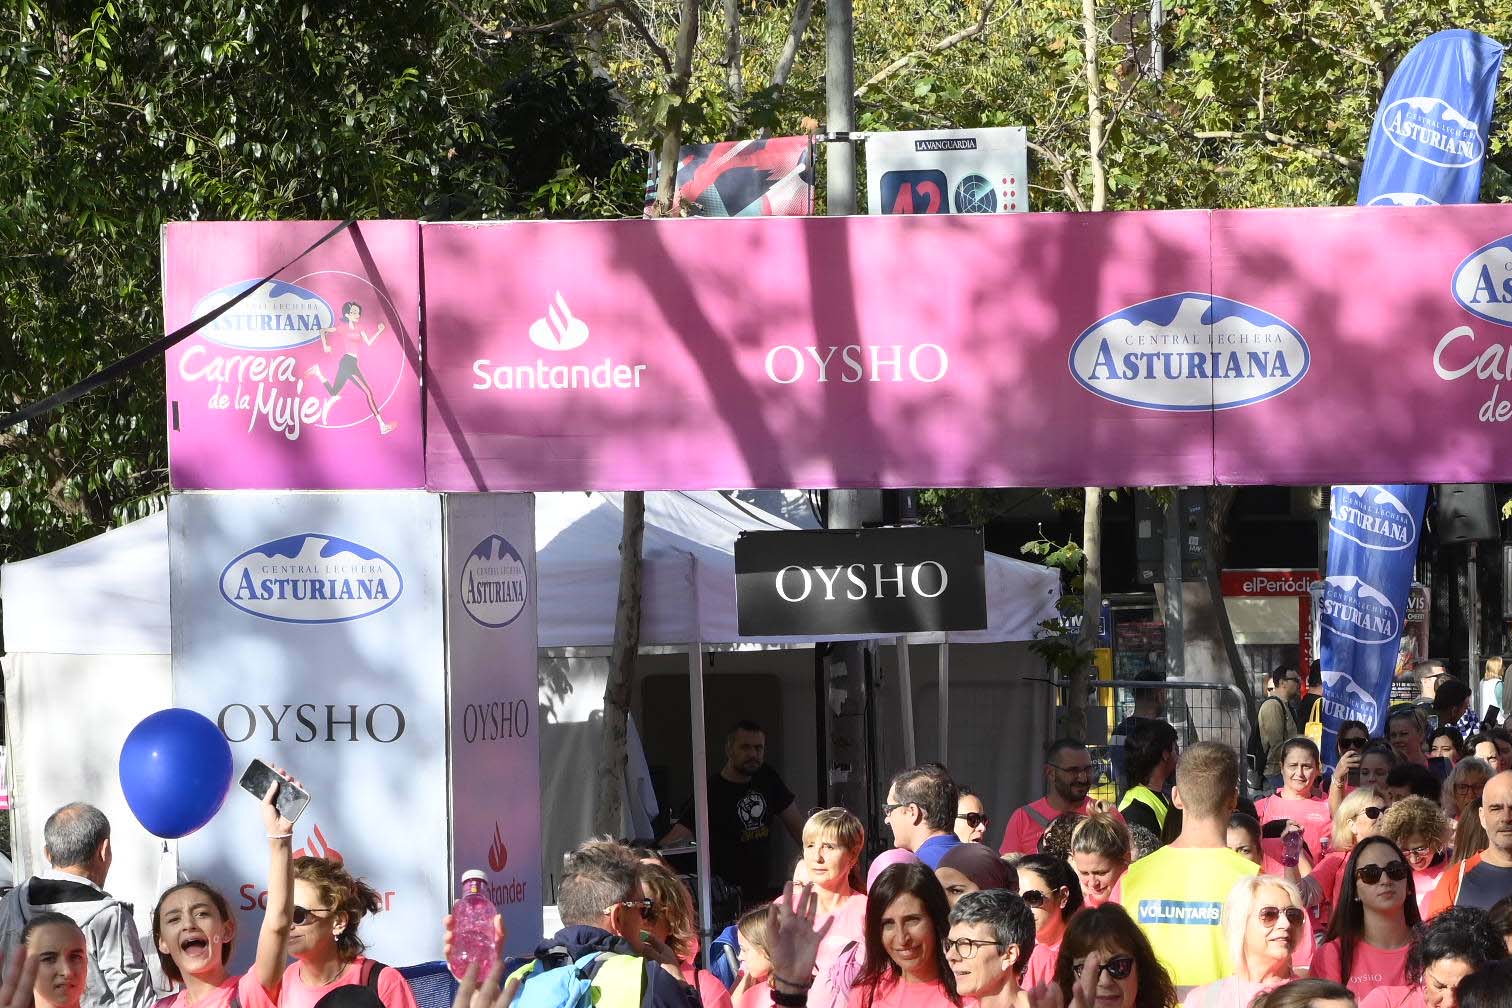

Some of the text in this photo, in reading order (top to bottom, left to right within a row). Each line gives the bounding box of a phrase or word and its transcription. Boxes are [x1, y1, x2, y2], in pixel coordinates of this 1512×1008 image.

[1125, 332, 1283, 345] CENTRAL LECHERA
[178, 344, 297, 383] Carrera
[473, 358, 646, 391] Santander
[764, 343, 949, 384] OYSHO
[1088, 336, 1292, 381] ASTURIANA
[208, 378, 341, 440] de la Mujer
[1479, 384, 1512, 423] de
[234, 567, 390, 602] ASTURIANA
[261, 564, 384, 575] CENTRAL LECHERA
[466, 569, 525, 606] ASTURIANA
[775, 560, 948, 602] OYSHO
[1243, 576, 1312, 593] elPeriódi
[216, 702, 406, 744] OYSHO
[463, 700, 530, 743] OYSHO
[1139, 903, 1221, 921] VOLUNTARIS
